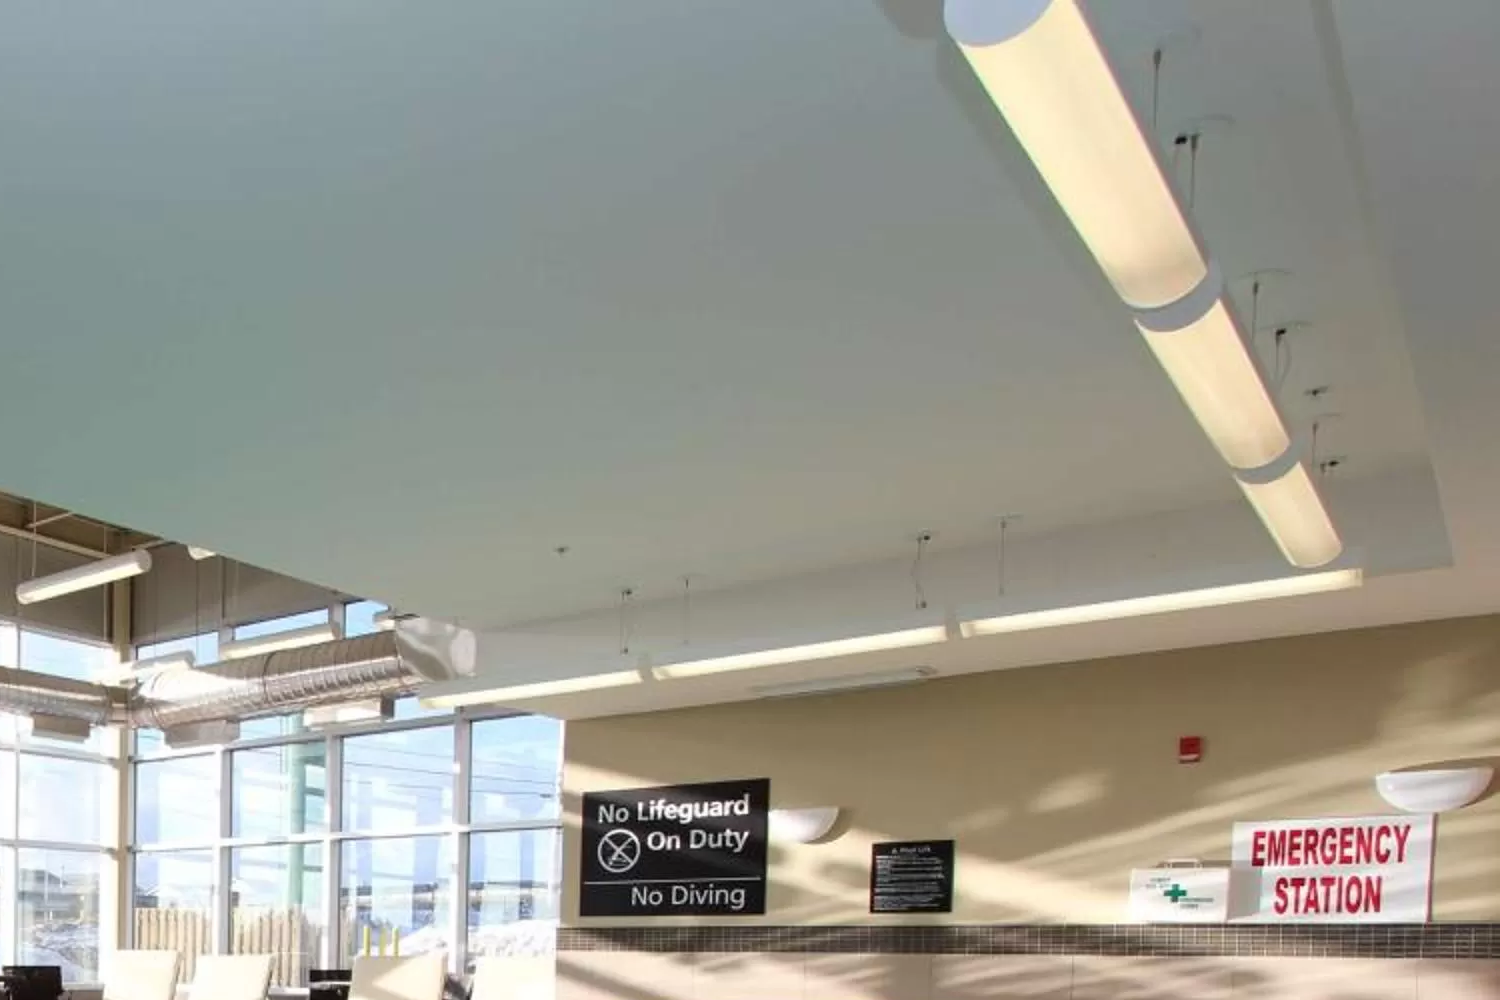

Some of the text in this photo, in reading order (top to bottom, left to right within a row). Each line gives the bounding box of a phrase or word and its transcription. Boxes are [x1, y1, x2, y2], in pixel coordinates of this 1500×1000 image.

[598, 793, 750, 825] No Lifeguard
[647, 828, 749, 853] On Duty
[1251, 824, 1411, 867] EMERGENCY
[631, 884, 746, 910] No Diving
[1273, 875, 1382, 914] STATION
